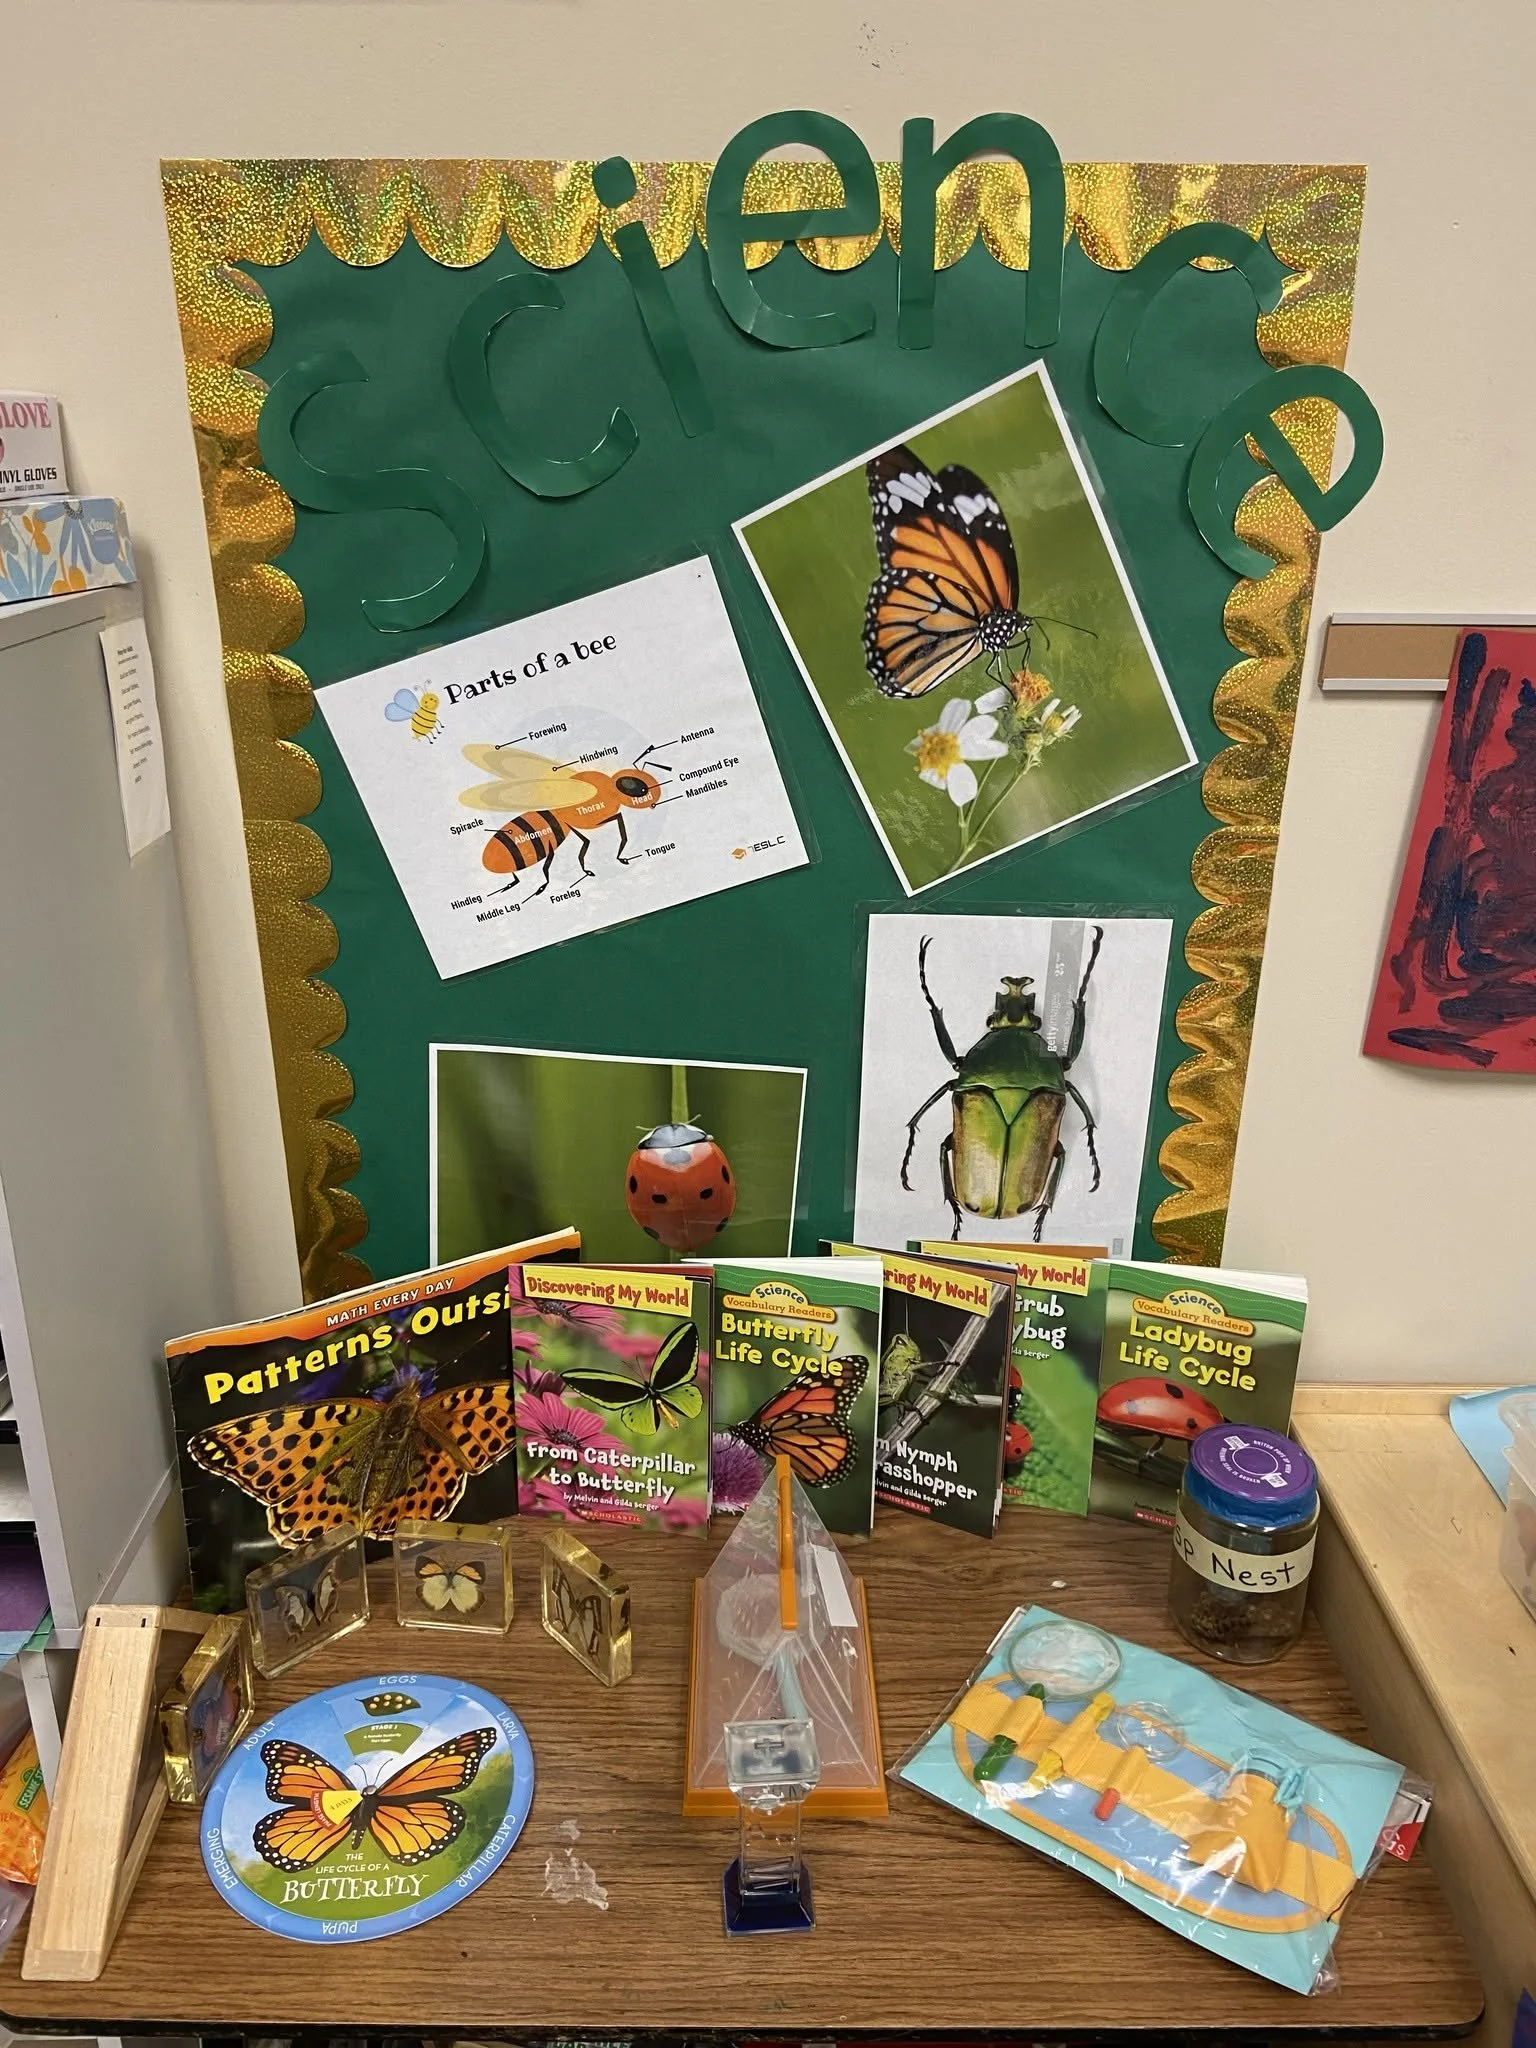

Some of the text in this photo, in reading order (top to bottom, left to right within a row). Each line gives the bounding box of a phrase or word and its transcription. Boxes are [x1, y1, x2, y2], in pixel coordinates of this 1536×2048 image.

[257, 110, 1383, 634] Science
[24, 467, 57, 482] GLOVES
[444, 635, 617, 705] Parts of a bee
[528, 722, 567, 740] Forewing
[680, 726, 715, 744] Antenna
[579, 746, 619, 764] Hindwing
[679, 757, 739, 782] Compound Eye
[632, 792, 653, 806] Head
[685, 778, 728, 798] Mandibles
[576, 800, 606, 816] Thorax
[450, 818, 484, 835] Spiracle
[514, 827, 552, 845] Abdomen
[645, 842, 676, 857] Tongue
[450, 894, 483, 910] Hindleg
[550, 889, 581, 904] Foreleg
[476, 903, 521, 922] Middle Leg
[1016, 1263, 1086, 1287] My World
[326, 1277, 455, 1326] MATH EVERY DAY
[526, 1276, 689, 1308] Discovering My World
[755, 1284, 805, 1304] Science
[920, 1274, 942, 1299] My
[945, 1281, 988, 1307] World
[727, 1297, 832, 1319] Vocabulary Readers
[1169, 1291, 1221, 1315] Science
[1138, 1300, 1250, 1333] Vocabulary Readers
[721, 1312, 838, 1352] Butterfly
[1129, 1315, 1253, 1366] Ladybug
[204, 1322, 392, 1405] Patterns
[715, 1339, 843, 1377] Life Cycle
[1119, 1341, 1257, 1391] Life Cycle
[527, 1442, 696, 1475] From Caterpillar
[896, 1440, 958, 1473] Nymph
[549, 1467, 675, 1504] to Butterfly
[890, 1484, 903, 1493] and
[904, 1488, 922, 1499] Gilda
[563, 1492, 573, 1504] by
[574, 1493, 599, 1504] Melvin
[600, 1495, 613, 1505] and
[614, 1497, 633, 1508] Gilda
[588, 1511, 642, 1523] SCHOLASTIC
[1211, 1552, 1295, 1586] Nest
[379, 1675, 418, 1685] EGGS
[242, 1720, 276, 1751] ADULT
[496, 1711, 521, 1740] LARVA
[19, 1780, 39, 1808] SESAME
[207, 1827, 238, 1890] EMERGING
[346, 1853, 364, 1861] THE
[455, 1814, 515, 1888] CATERPILLAR
[315, 1863, 390, 1874] LIFE CYCLE OF A
[279, 1873, 430, 1904] BUTTERFLY
[322, 1920, 358, 1935] PUPA
